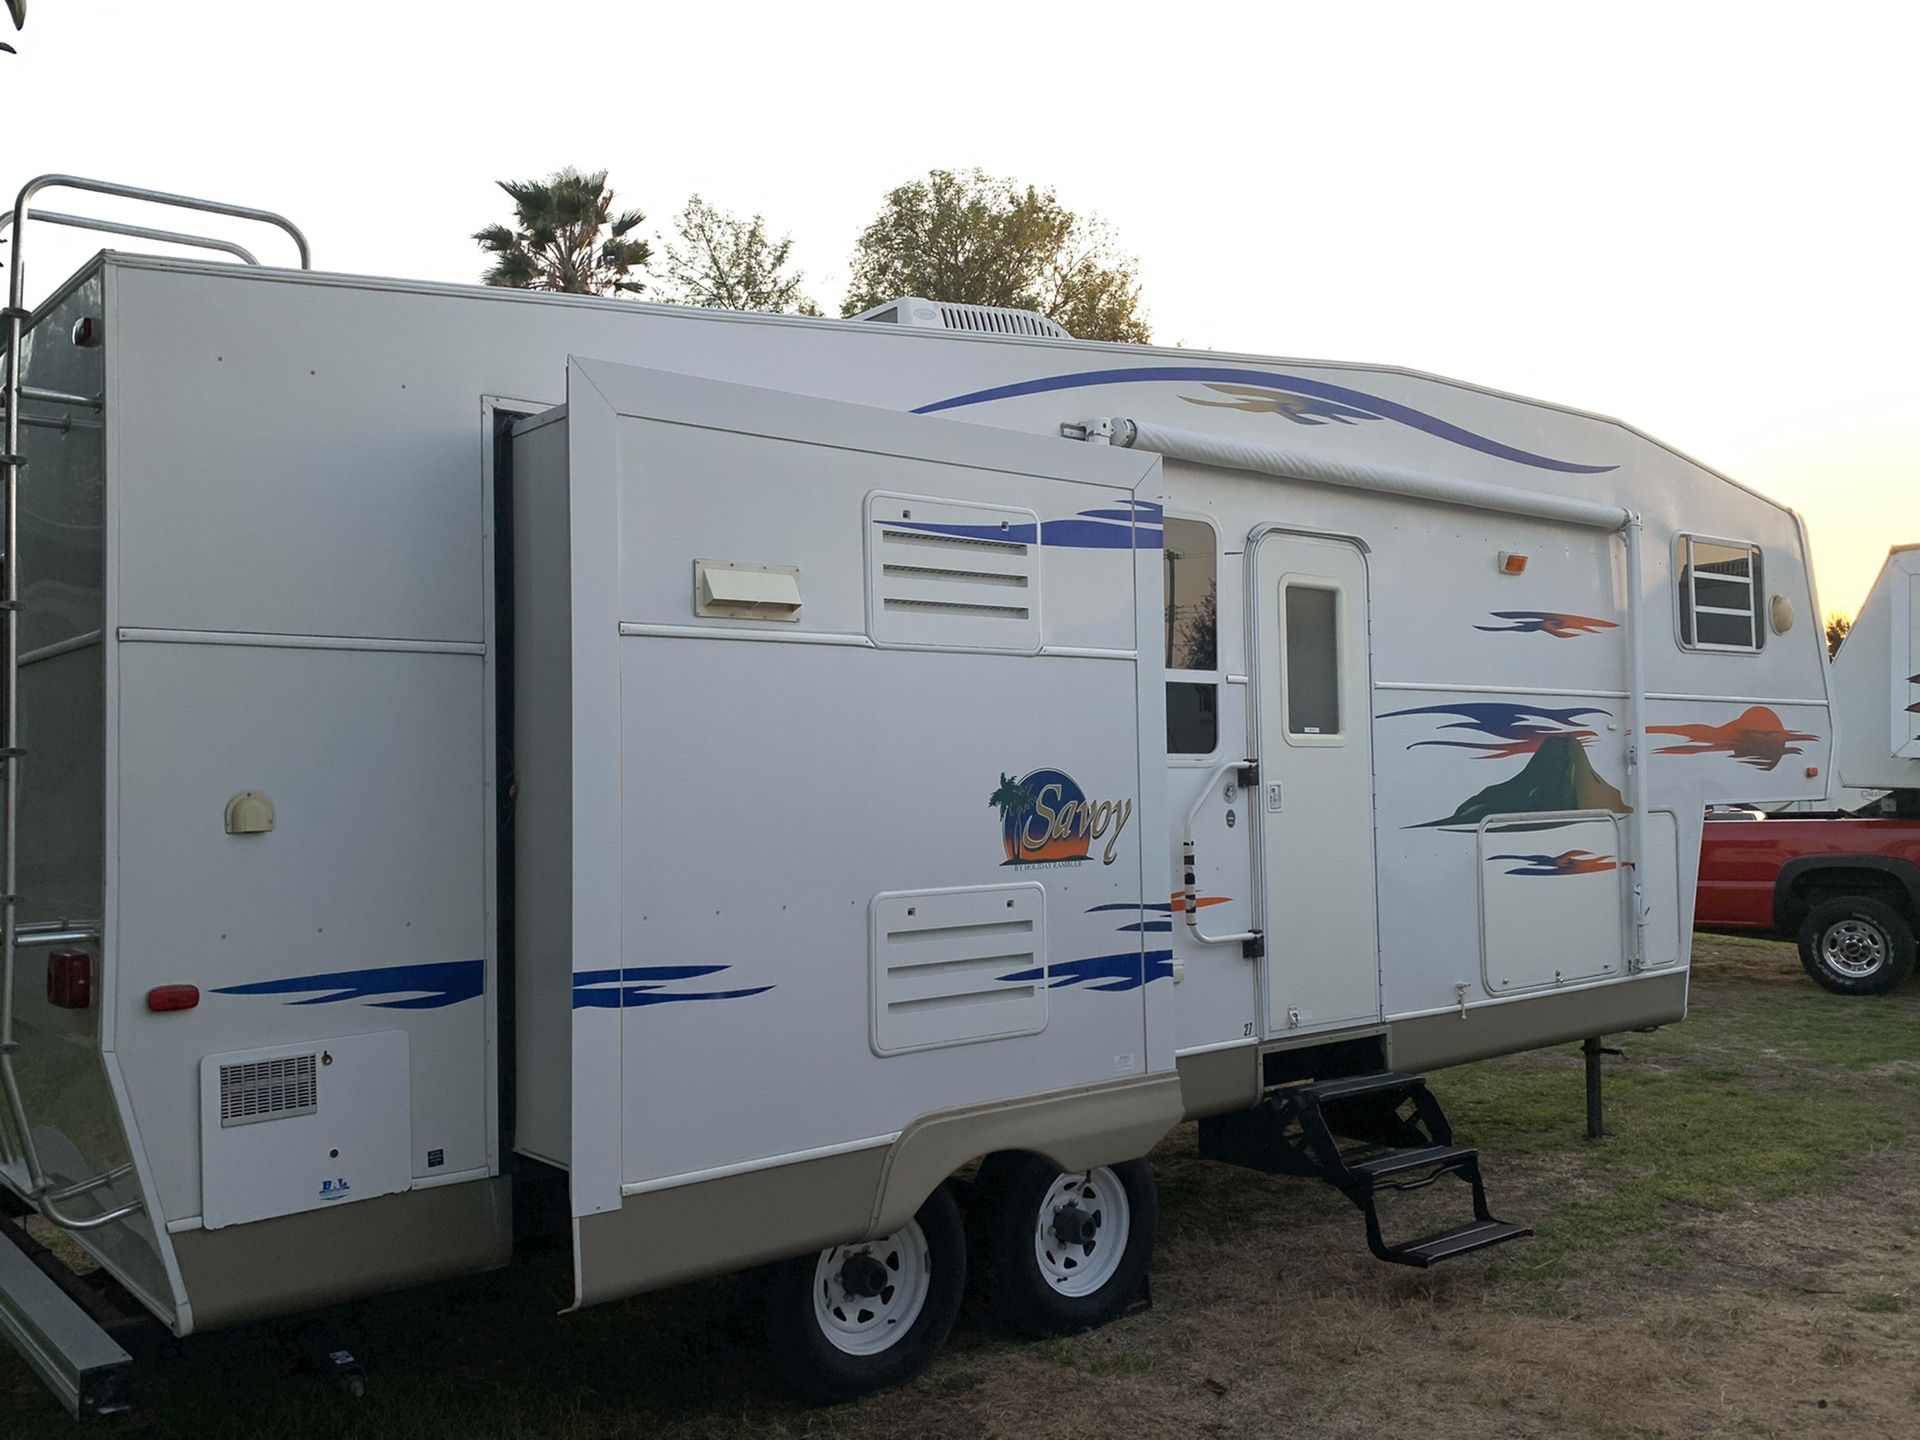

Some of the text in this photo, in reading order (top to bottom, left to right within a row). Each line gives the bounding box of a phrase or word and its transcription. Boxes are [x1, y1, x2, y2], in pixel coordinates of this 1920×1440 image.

[1022, 784, 1132, 866] Savoy
[1014, 861, 1082, 871] BY HOLIDAY RAMBLER
[1243, 1022, 1253, 1036] 27
